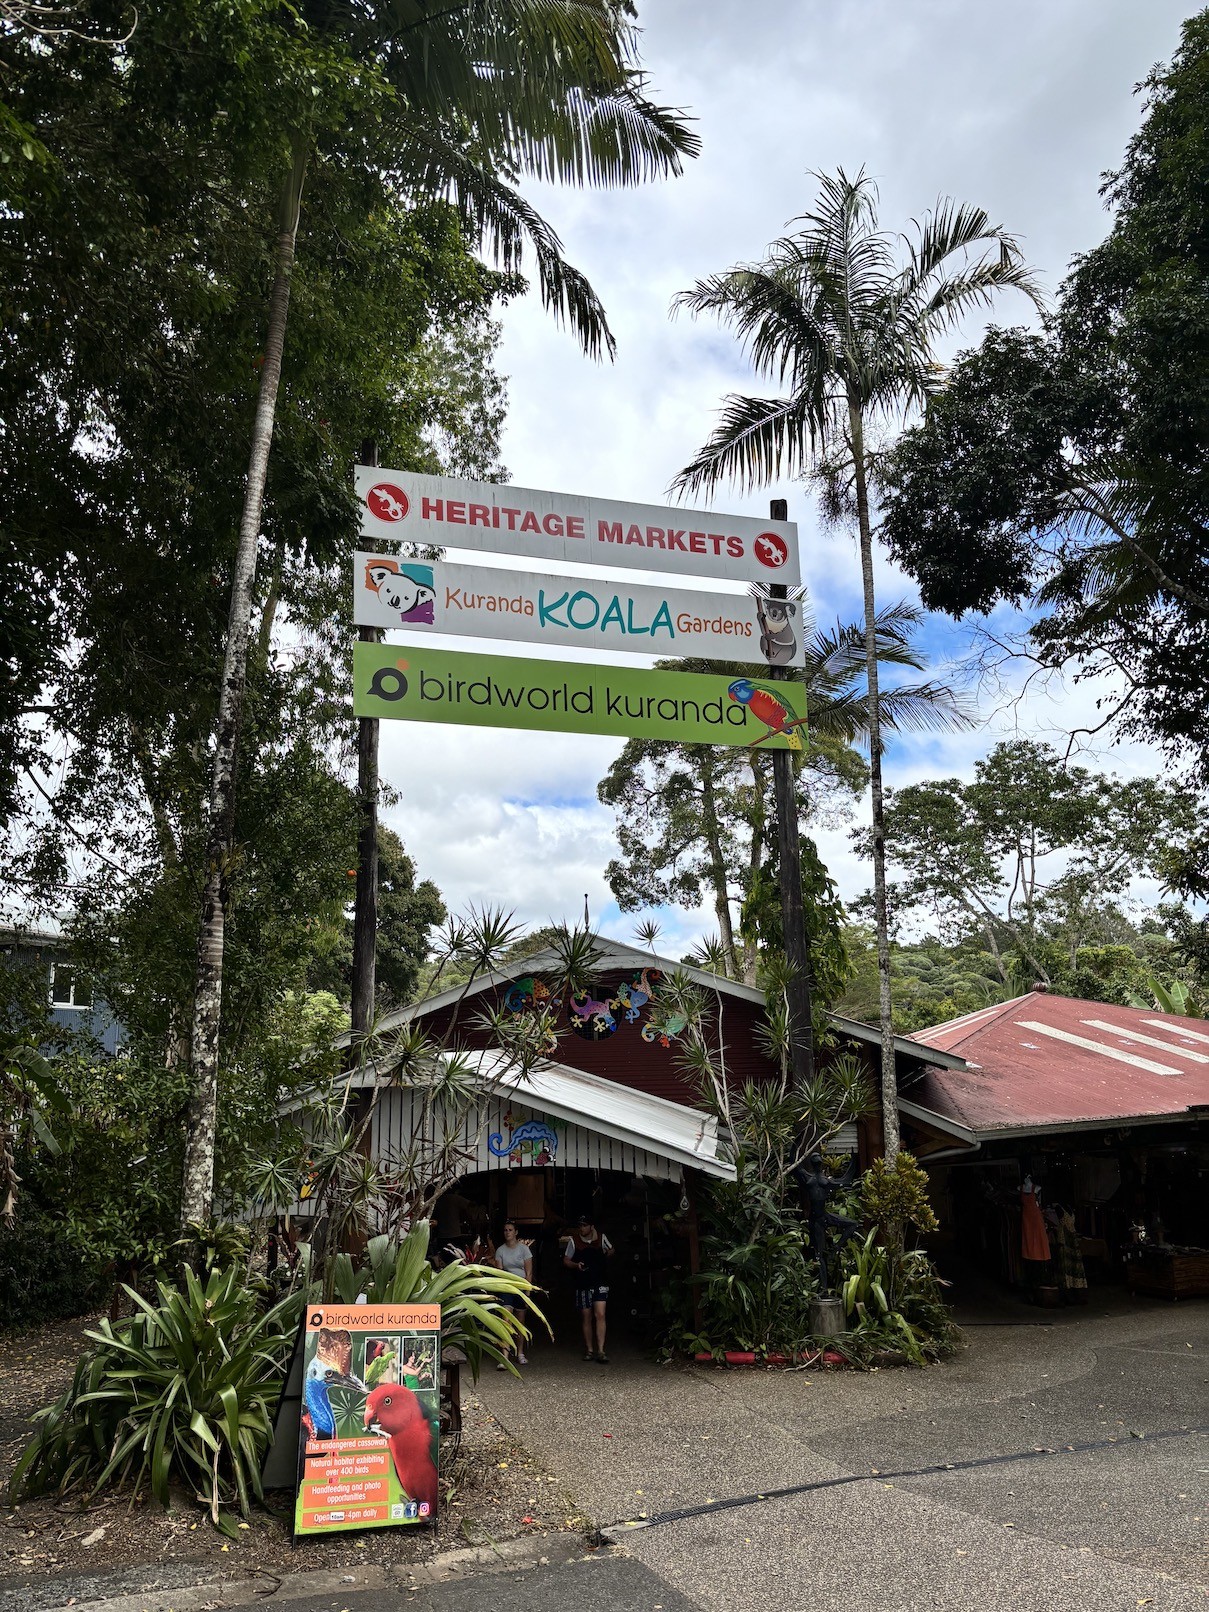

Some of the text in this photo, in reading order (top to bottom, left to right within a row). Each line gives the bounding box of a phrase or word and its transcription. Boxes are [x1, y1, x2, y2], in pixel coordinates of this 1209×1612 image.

[421, 497, 745, 558] HERITAGE MARKETS
[445, 586, 752, 639] Kuranda KOALA Gardens
[420, 670, 747, 726] birdworld kuranda
[326, 1312, 437, 1325] birdworld kuranda
[308, 1442, 319, 1450] The
[321, 1440, 356, 1450] endangered
[310, 1455, 385, 1467] Natural habitat exhibiting
[355, 1466, 369, 1474] birds
[311, 1485, 350, 1494] Handfeeding
[364, 1482, 382, 1491] photo
[326, 1493, 366, 1503] opportunities
[362, 1508, 378, 1517] daily
